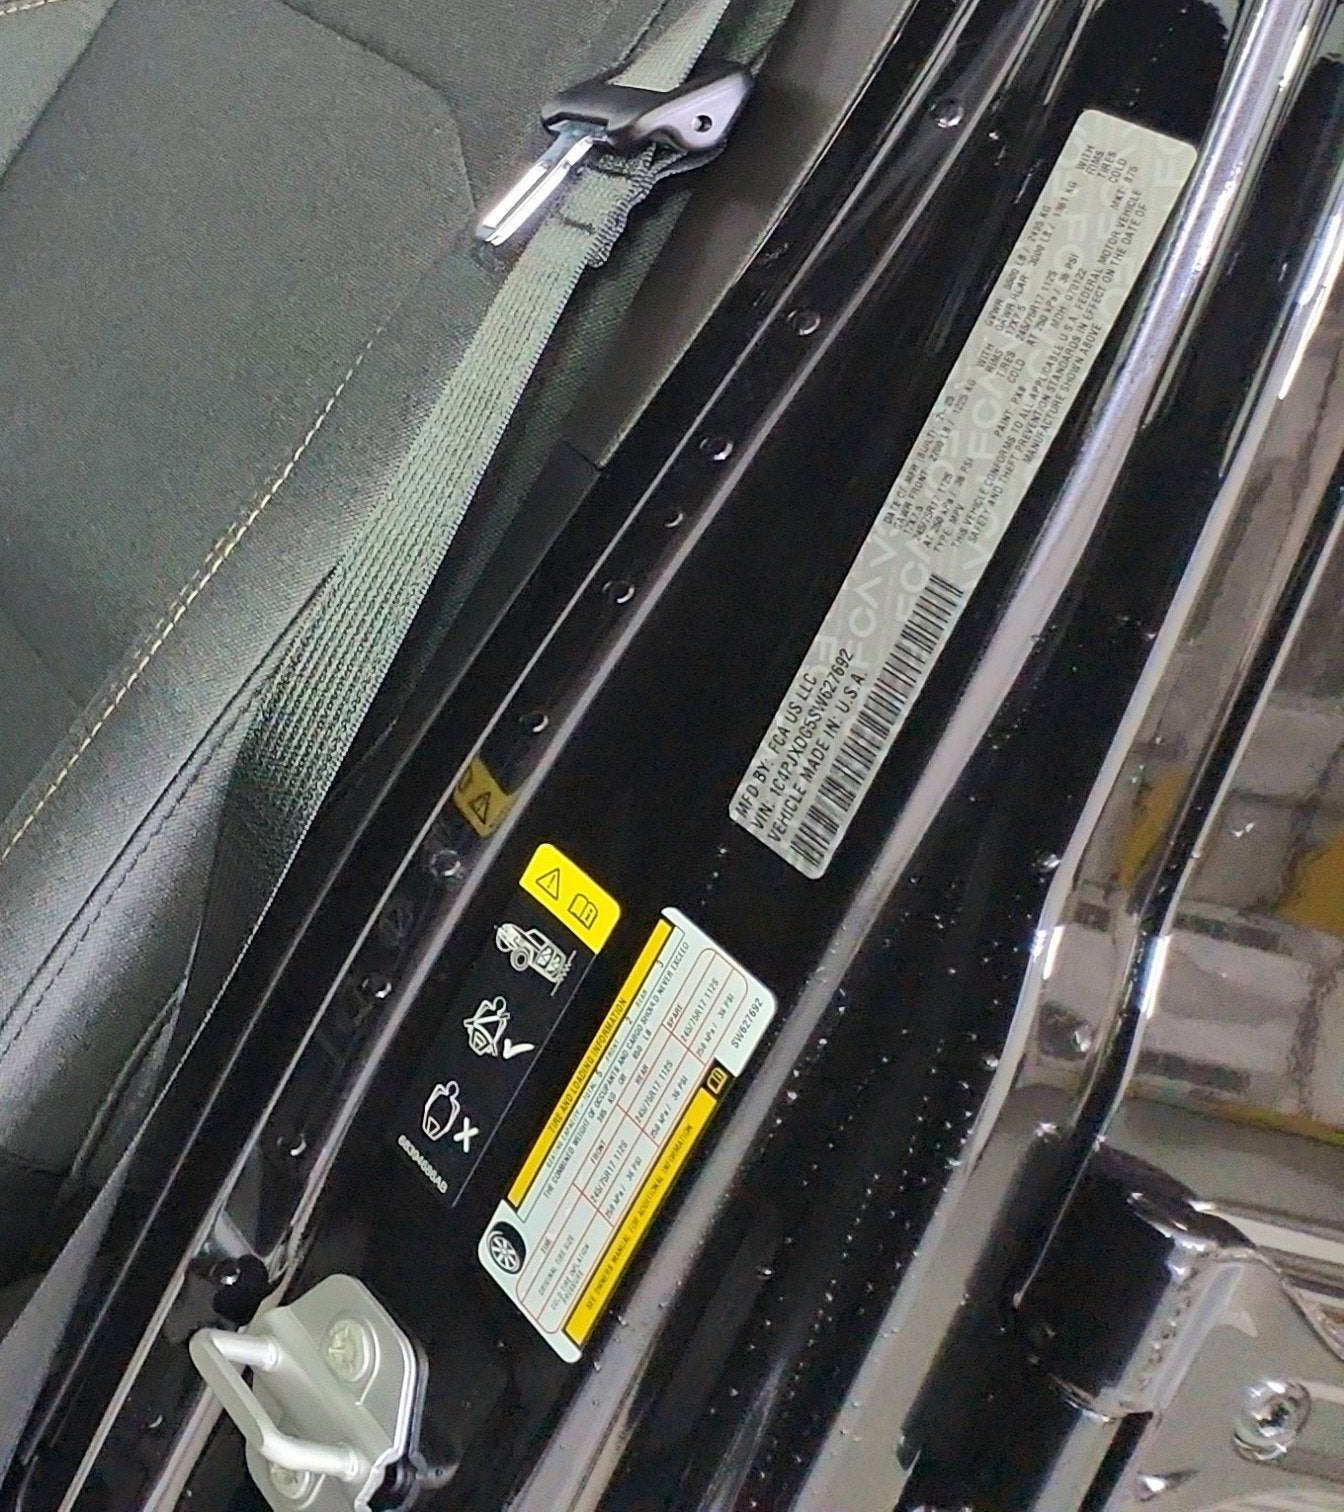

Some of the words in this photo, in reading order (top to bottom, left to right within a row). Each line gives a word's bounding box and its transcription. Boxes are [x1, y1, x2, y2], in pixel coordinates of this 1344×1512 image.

[1063, 179, 1077, 194] KG
[1075, 144, 1095, 170] WITH
[1084, 149, 1105, 175] RIMS
[1096, 150, 1117, 179] TIRES
[1114, 187, 1143, 229] VEHICLE
[1133, 202, 1150, 218] OF
[1095, 229, 1122, 265] MOTOR
[1120, 218, 1141, 246] DATE
[1025, 332, 1038, 347] AT
[1064, 252, 1079, 270] PSI
[1107, 157, 1128, 184] COLD
[1109, 246, 1127, 266] THE
[1072, 265, 1103, 310] FEDERAL
[1100, 267, 1116, 284] ON
[1081, 284, 1107, 321] EFFECT
[1075, 321, 1088, 334] IN
[975, 341, 995, 368] WITH
[985, 347, 1004, 373] RIMS
[995, 349, 1016, 378] TIRES
[1027, 342, 1063, 400] APPLICABLE
[1044, 334, 1082, 393] STANDARDS
[1016, 399, 1034, 420] ALL
[1022, 391, 1066, 464] MANUFACTURE
[1058, 355, 1084, 392] SHOWN
[1077, 322, 1101, 356] ABOVE
[960, 456, 974, 474] PSI
[1005, 357, 1025, 384] COLD
[1009, 419, 1024, 434] TO
[1014, 392, 1051, 453] PREVENTION
[982, 434, 1016, 488] CONFORMS
[998, 453, 1020, 485] THEFT
[948, 502, 965, 525] MPV
[962, 485, 990, 527] VEHICLE
[986, 484, 1004, 507] AND
[950, 526, 969, 550] THIS
[967, 507, 992, 545] SAFETY
[734, 782, 760, 819] MFD
[752, 755, 774, 784] BY:
[767, 722, 791, 755] FCA
[782, 699, 802, 725] US
[794, 671, 817, 701] LLC
[751, 797, 776, 832] VIN:
[768, 646, 853, 798] 1C4PJXDG5SW627692
[768, 782, 807, 845] VEHICLE
[799, 737, 830, 784] MADE
[821, 713, 843, 740] IN:
[834, 665, 867, 715] U.S.A.
[729, 995, 763, 1049] SW627692
[542, 1182, 554, 1199] THE
[551, 1145, 575, 1184] COMBINED
[571, 1117, 590, 1147] WEIGHT
[587, 1107, 596, 1119] OF
[593, 1064, 620, 1109] OCCUPANTS
[616, 1048, 629, 1067] AND
[625, 1022, 643, 1050] CARGO
[639, 993, 660, 1025] SHOULD
[656, 969, 673, 996] NEVER
[670, 940, 689, 971] EXCEED
[547, 1110, 563, 1134] TIRE
[559, 1092, 573, 1113] AND
[569, 1054, 594, 1094] LOADING
[590, 996, 627, 1057] INFORMATION
[589, 1138, 606, 1165] FRONT
